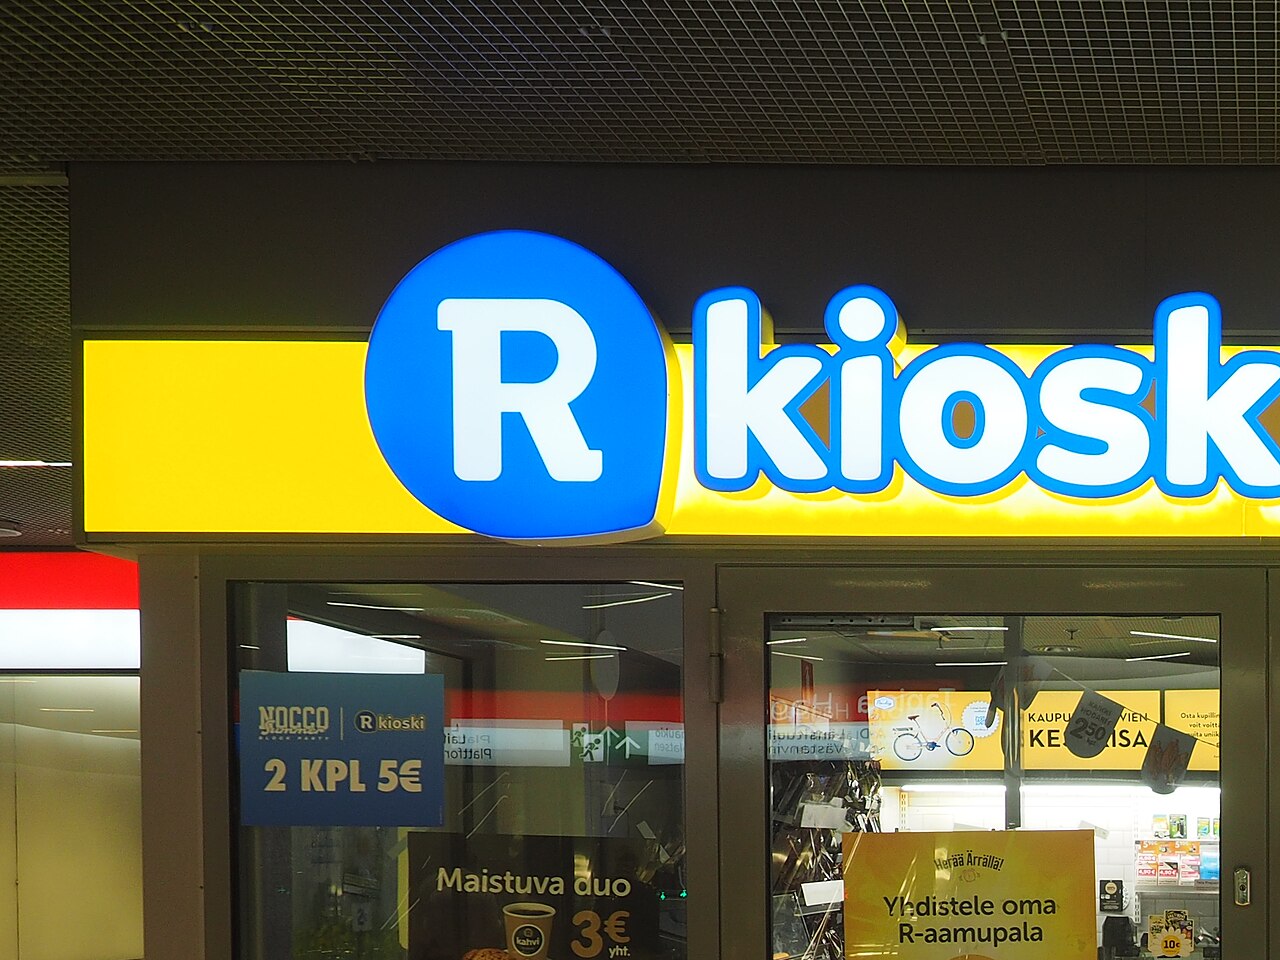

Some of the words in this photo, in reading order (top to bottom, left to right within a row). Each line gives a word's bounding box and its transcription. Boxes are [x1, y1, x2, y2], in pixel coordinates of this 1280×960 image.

[436, 297, 603, 482] R
[258, 706, 330, 730] NOCCO
[378, 714, 426, 731] kioski
[1180, 712, 1196, 721] Osta
[1189, 722, 1201, 730] voit
[264, 758, 288, 792] 2
[301, 759, 367, 792] KPL
[377, 759, 423, 793] 5€
[933, 853, 965, 871] Herää
[966, 849, 1005, 872] Ärrällä!
[436, 866, 565, 895] Maistuva
[574, 871, 632, 898] duo
[883, 895, 995, 917] Yhdistele
[1001, 898, 1057, 916] oma
[515, 936, 541, 947] kahvi
[898, 922, 1044, 947] R-aamupala
[608, 946, 631, 959] yht.
